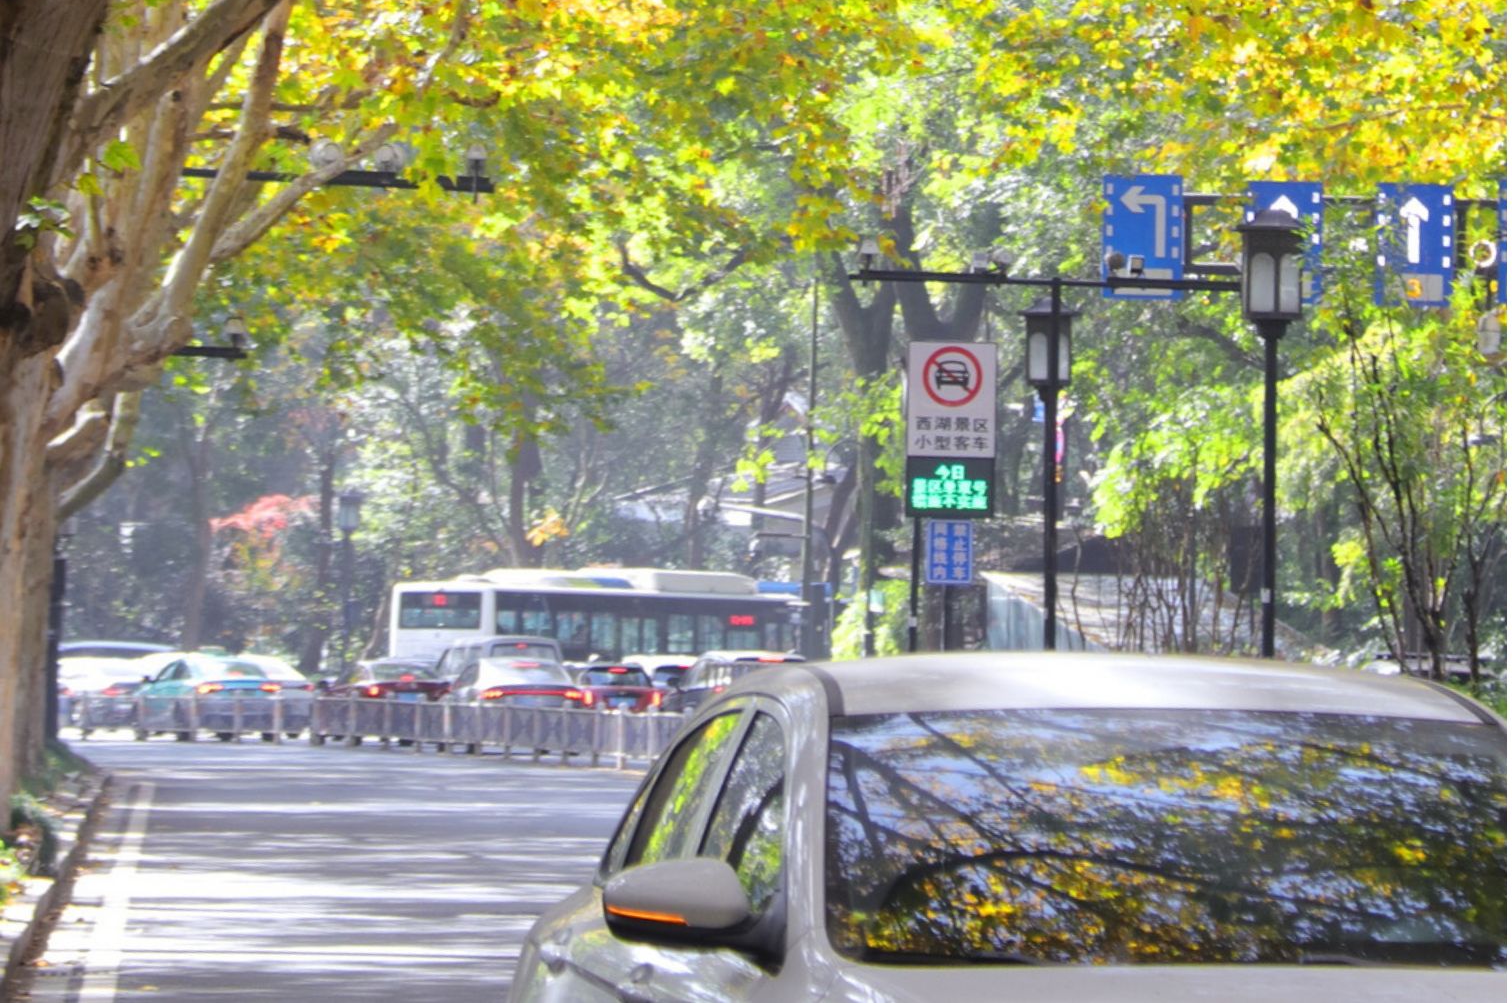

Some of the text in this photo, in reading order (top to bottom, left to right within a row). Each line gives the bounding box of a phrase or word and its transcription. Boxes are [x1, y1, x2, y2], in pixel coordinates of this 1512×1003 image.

[915, 416, 989, 433] 西湖景区
[914, 434, 989, 451] 小型客车
[934, 464, 965, 480] 今日
